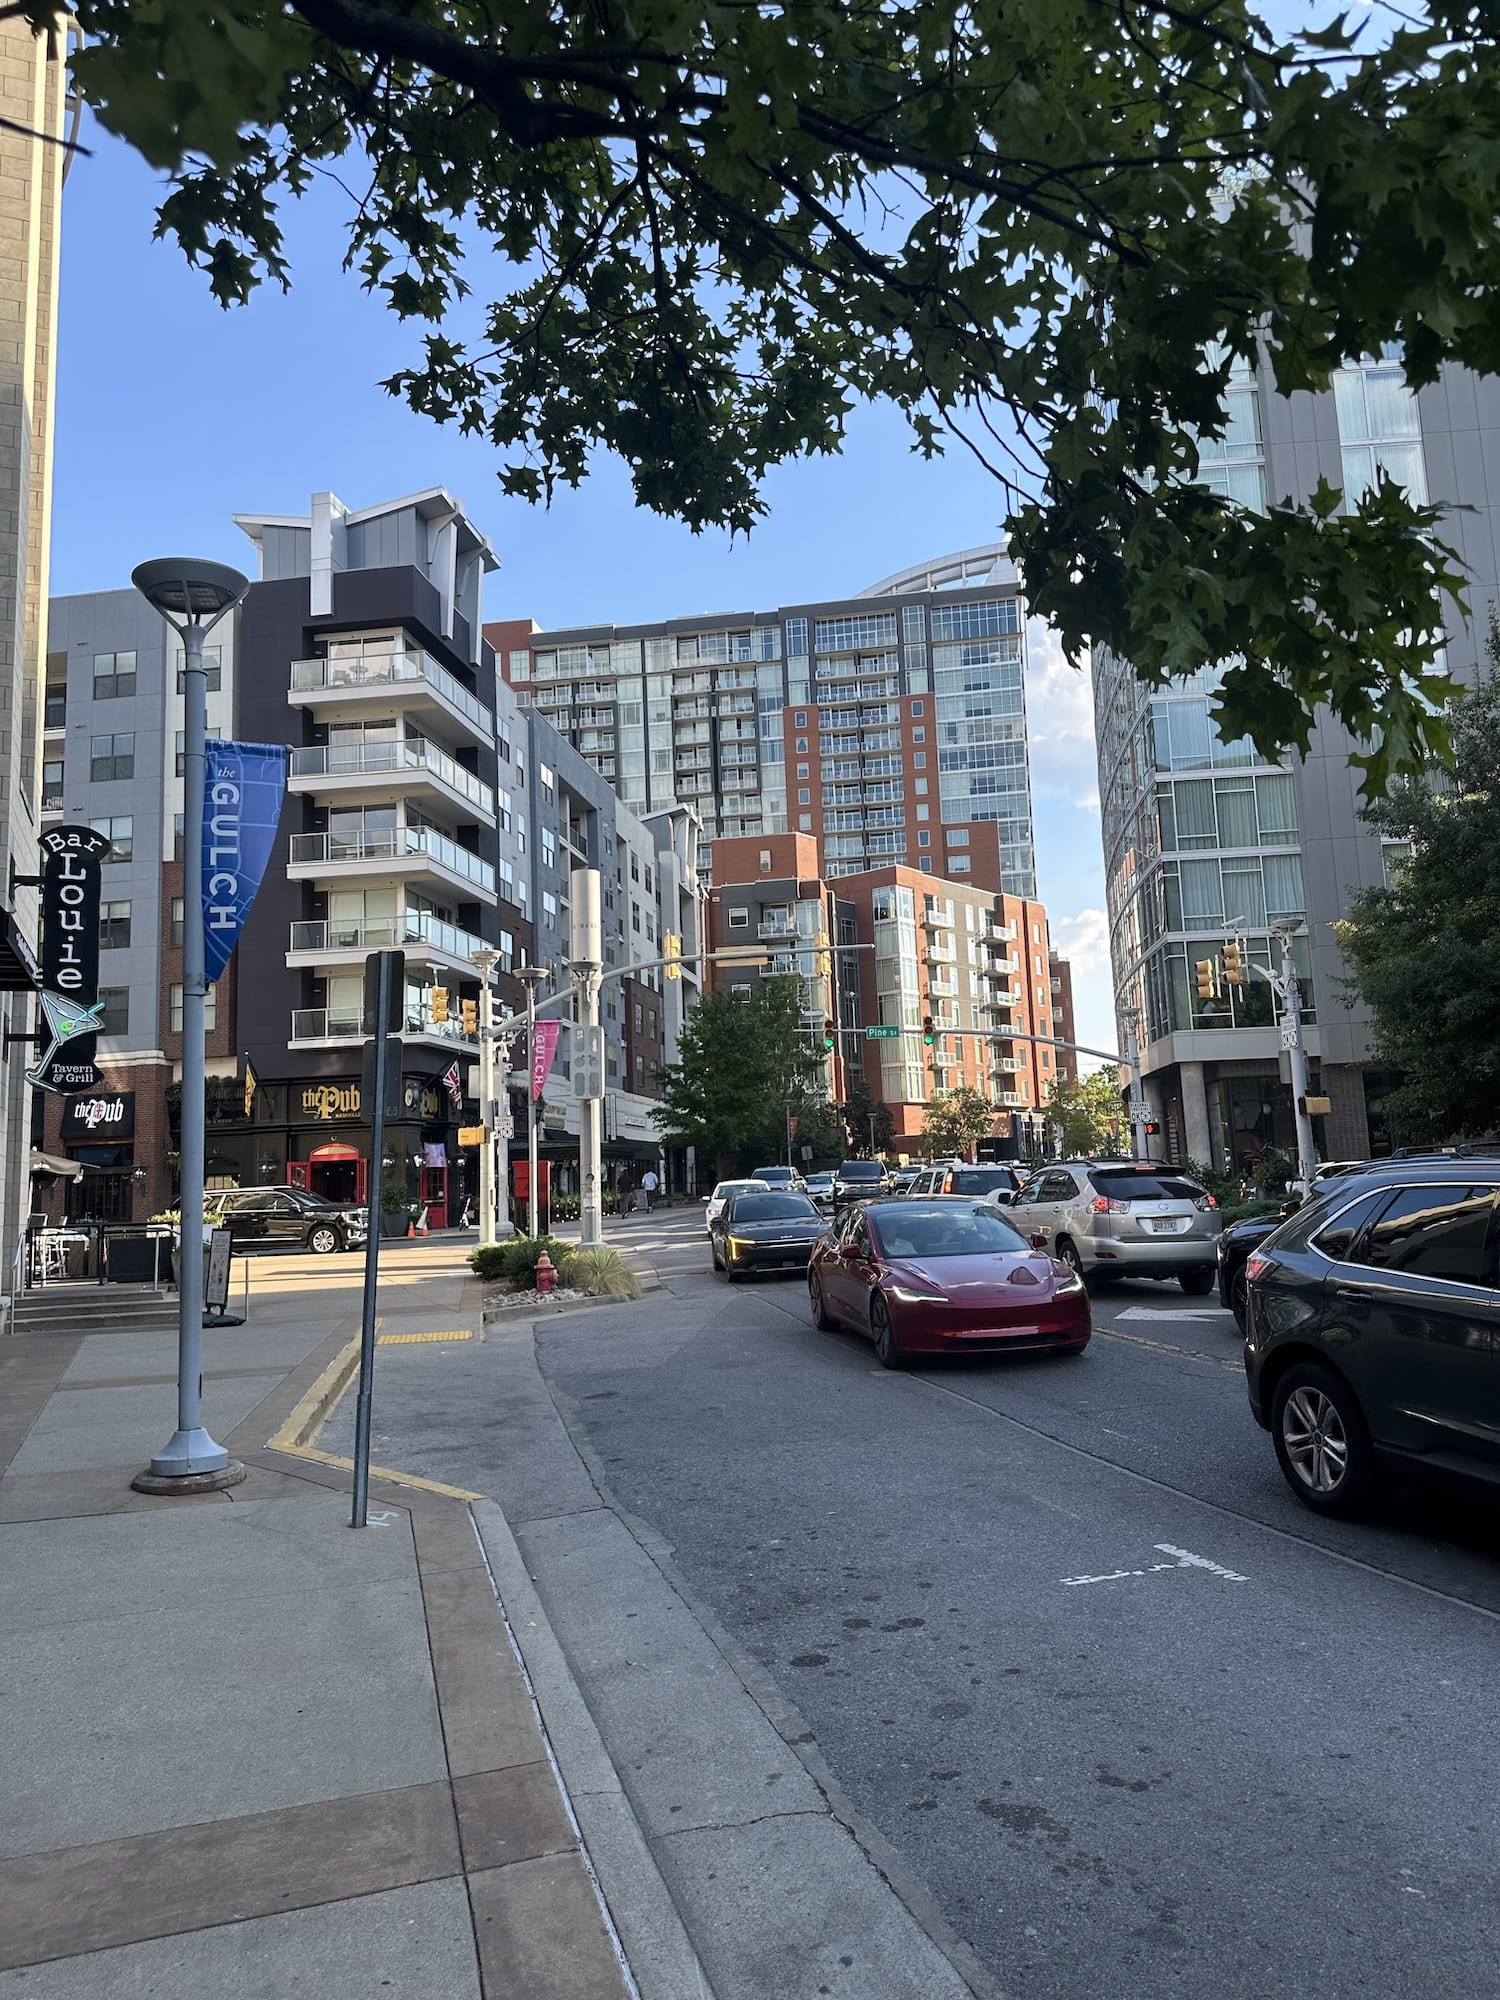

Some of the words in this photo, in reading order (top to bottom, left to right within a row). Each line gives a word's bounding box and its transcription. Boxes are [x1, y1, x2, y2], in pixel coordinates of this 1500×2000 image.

[217, 766, 236, 778] the
[44, 832, 103, 853] Bar
[209, 782, 240, 929] GULCH
[56, 852, 87, 989] Louie
[868, 1028, 887, 1037] Pine
[52, 1064, 93, 1073] Tavern
[535, 1035, 545, 1084] GULCH
[52, 1073, 64, 1083] &
[66, 1074, 94, 1083] Grill
[74, 1102, 91, 1118] the
[85, 1098, 124, 1128] Pub
[302, 1088, 321, 1108] the
[315, 1084, 361, 1119] Pub
